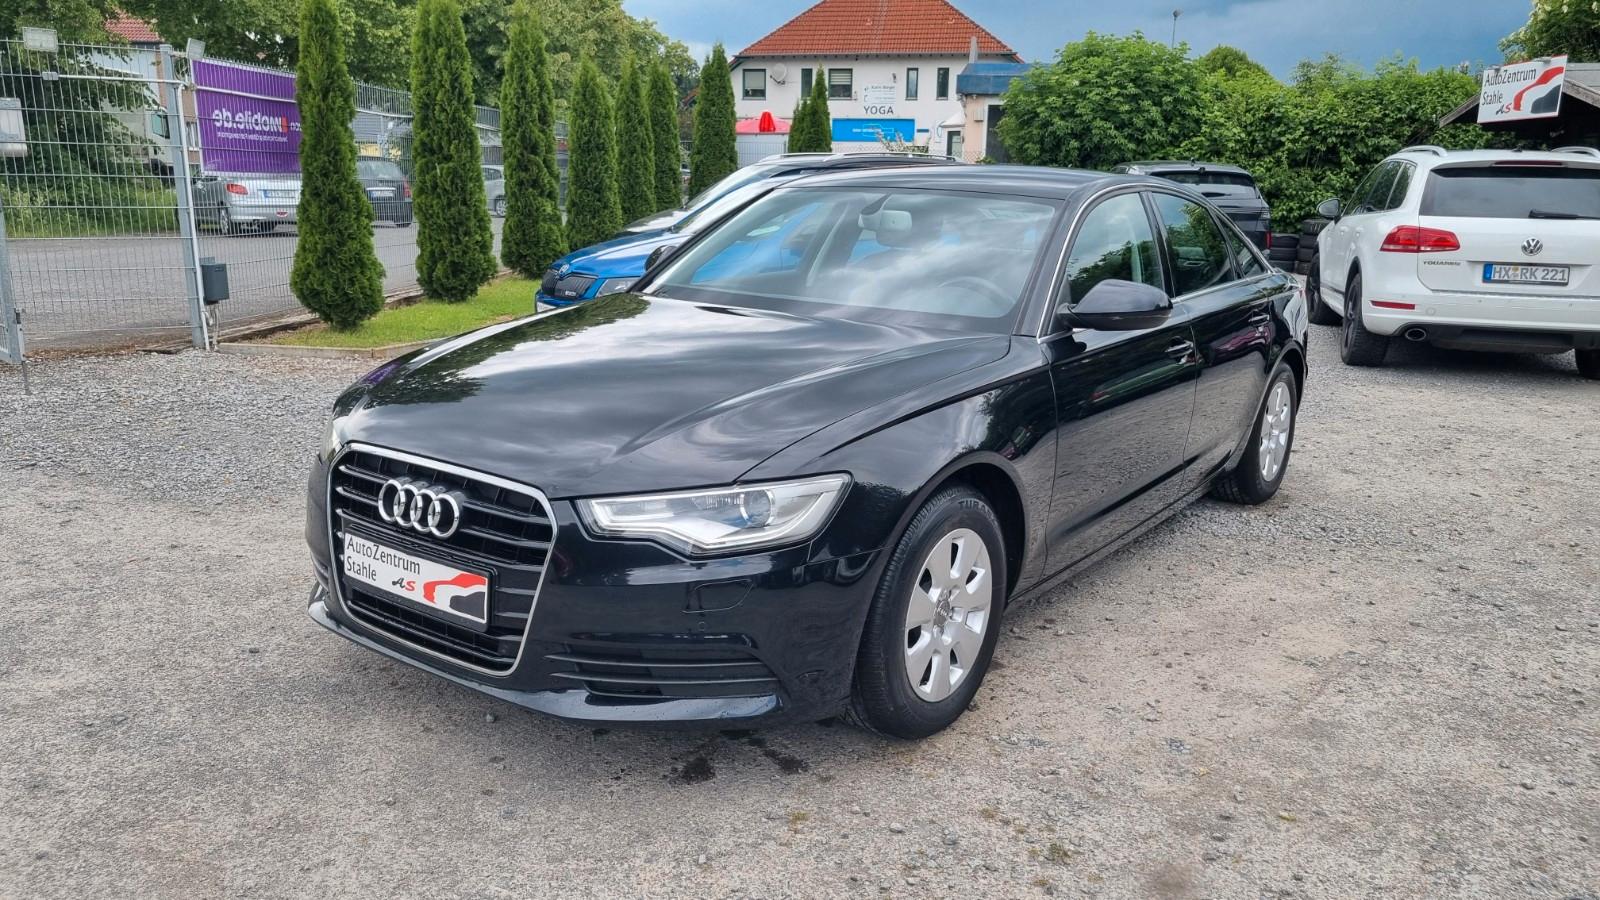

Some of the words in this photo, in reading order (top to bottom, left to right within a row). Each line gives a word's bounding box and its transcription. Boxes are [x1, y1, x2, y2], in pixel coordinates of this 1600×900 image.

[1484, 68, 1536, 87] AutoZentrum
[1481, 90, 1503, 105] Stahle
[863, 105, 894, 115] YOGA
[1492, 266, 1511, 280] HX
[1519, 268, 1538, 281] RK
[1541, 268, 1567, 282] 221
[346, 537, 421, 576] AutoZentrum
[346, 556, 377, 582] Stahle
[391, 577, 416, 592] AS
